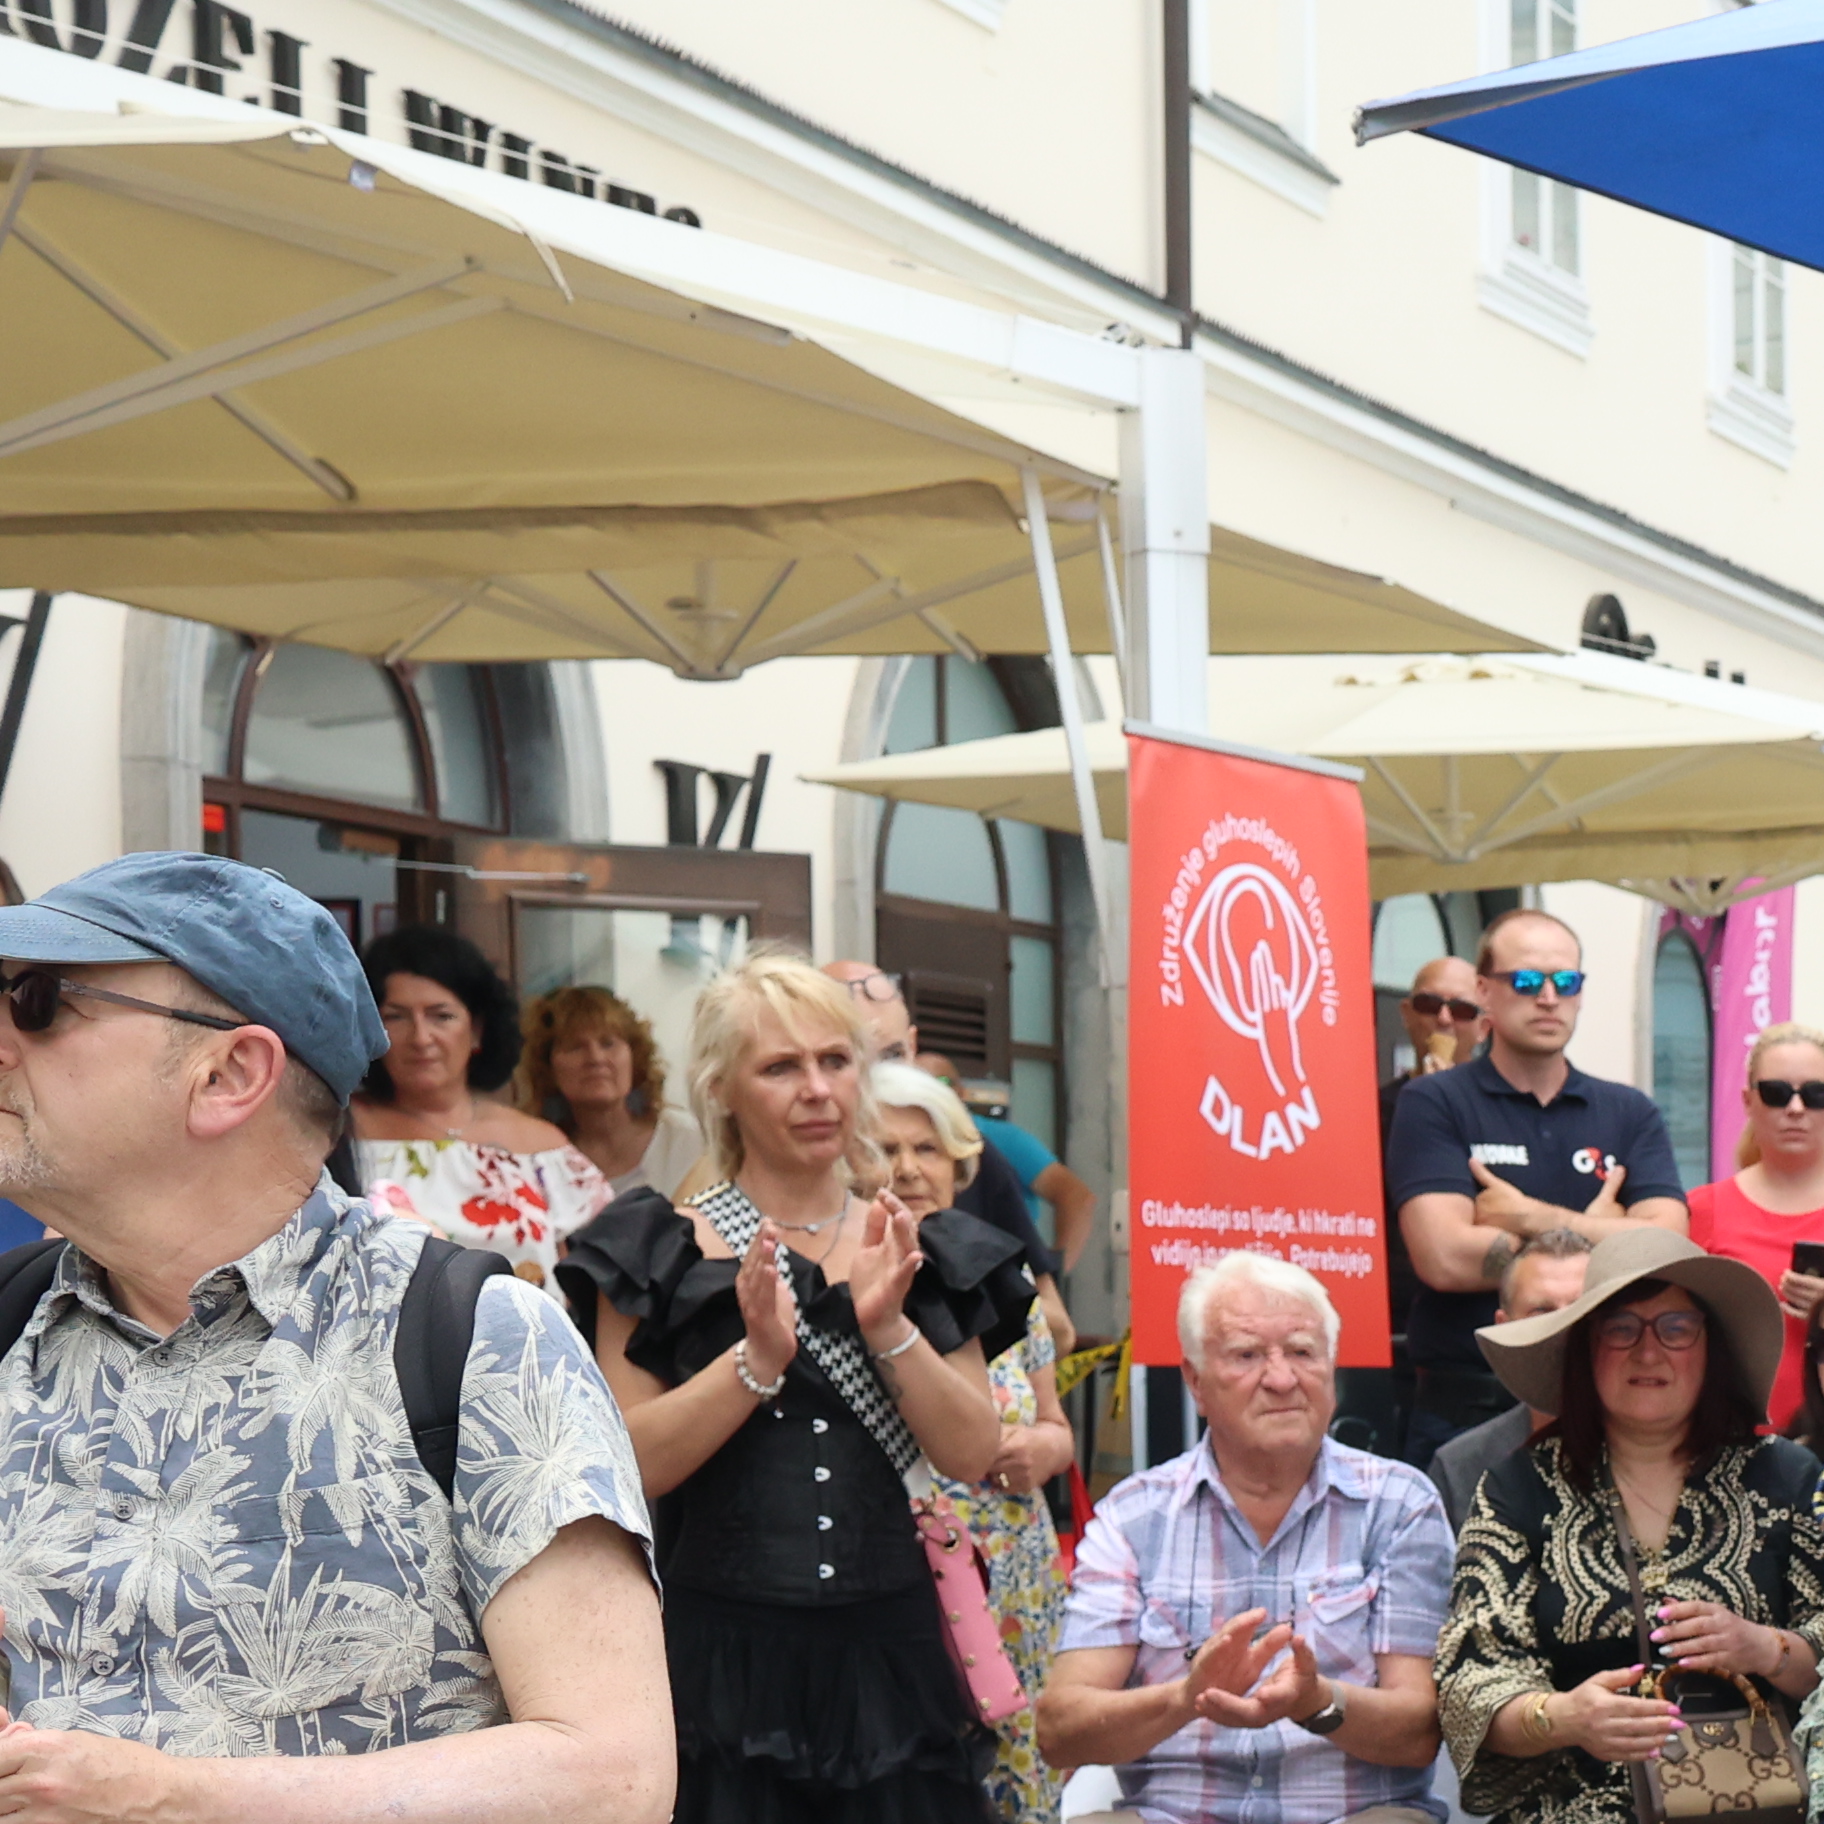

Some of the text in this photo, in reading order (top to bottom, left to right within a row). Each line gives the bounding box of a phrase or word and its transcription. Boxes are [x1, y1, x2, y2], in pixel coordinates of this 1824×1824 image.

[1158, 846, 1206, 1008] Združenje
[1298, 874, 1341, 1027] Slovenije
[1199, 1074, 1322, 1161] DLAN
